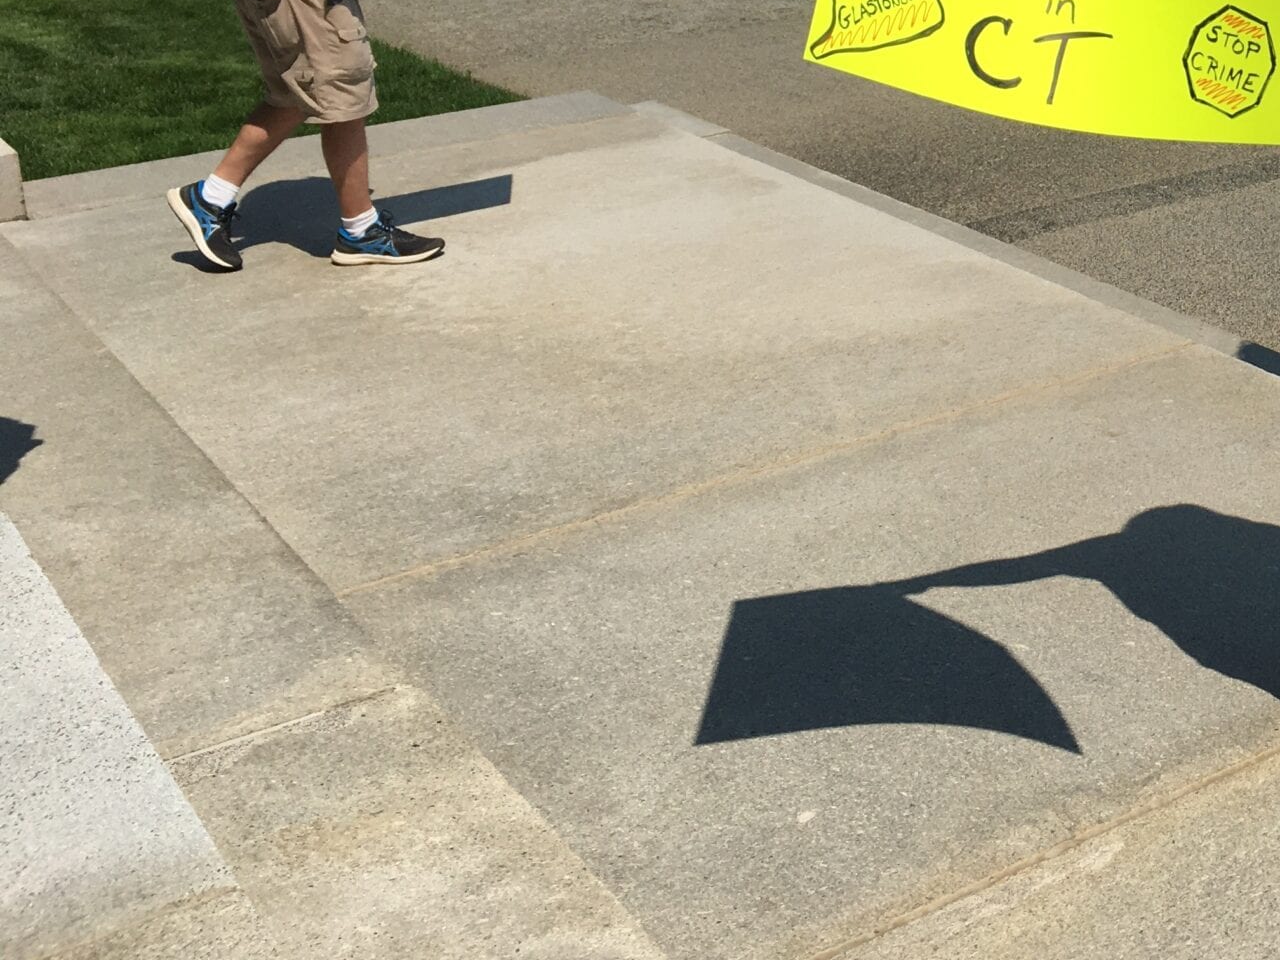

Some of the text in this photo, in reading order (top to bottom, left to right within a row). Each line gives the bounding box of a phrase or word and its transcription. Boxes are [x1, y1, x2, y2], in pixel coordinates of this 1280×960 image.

[964, 15, 1114, 106] CT
[1206, 25, 1261, 59] STOP
[1191, 51, 1260, 93] CRIME
